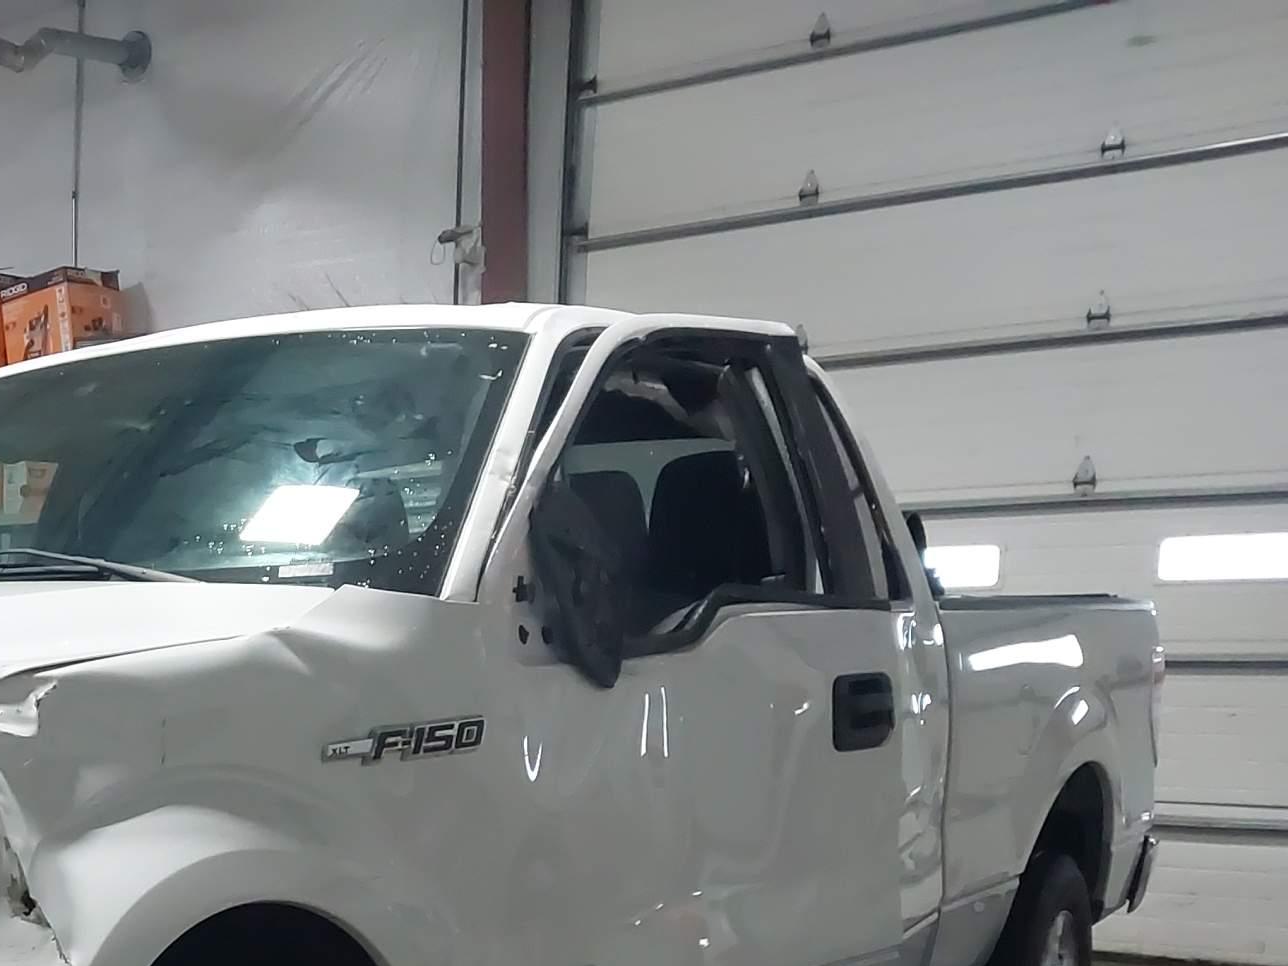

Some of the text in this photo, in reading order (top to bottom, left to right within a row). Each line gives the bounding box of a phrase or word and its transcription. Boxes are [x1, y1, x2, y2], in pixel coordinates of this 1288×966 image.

[0, 283, 28, 298] RIDGID
[330, 718, 486, 761] XLT F-150
